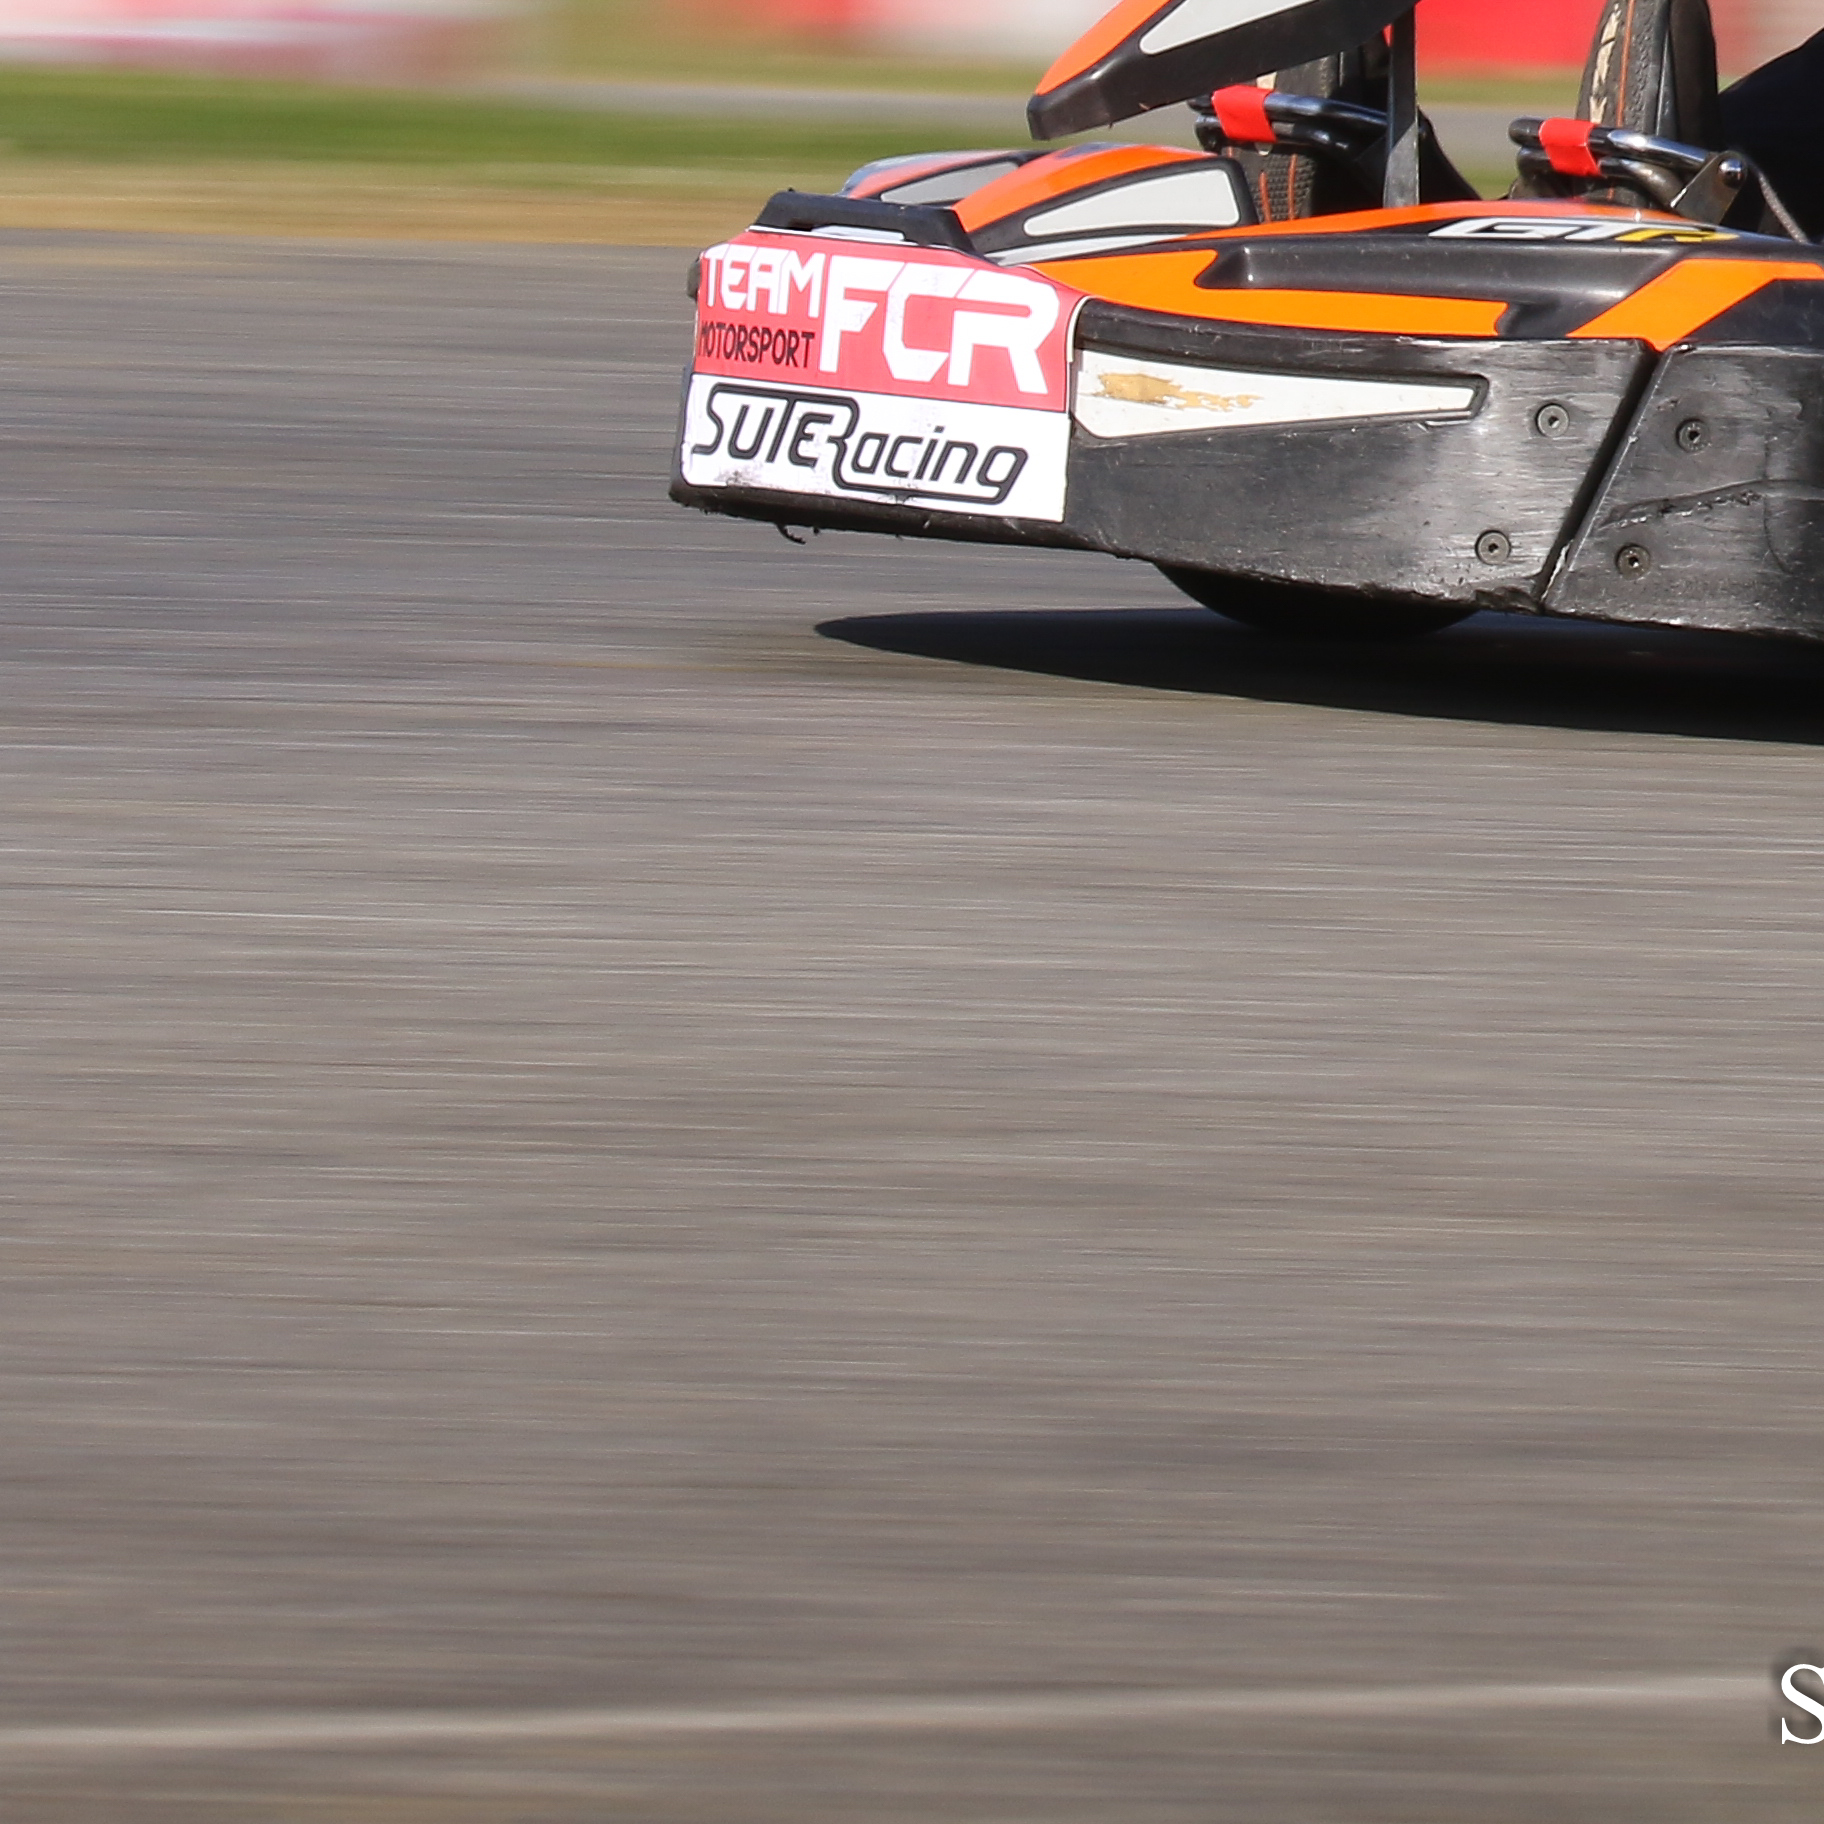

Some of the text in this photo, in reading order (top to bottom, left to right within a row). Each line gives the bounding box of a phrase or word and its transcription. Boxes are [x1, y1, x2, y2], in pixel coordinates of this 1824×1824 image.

[698, 319, 816, 369] MOTORSPORT
[702, 243, 1061, 395] TEAM FCR
